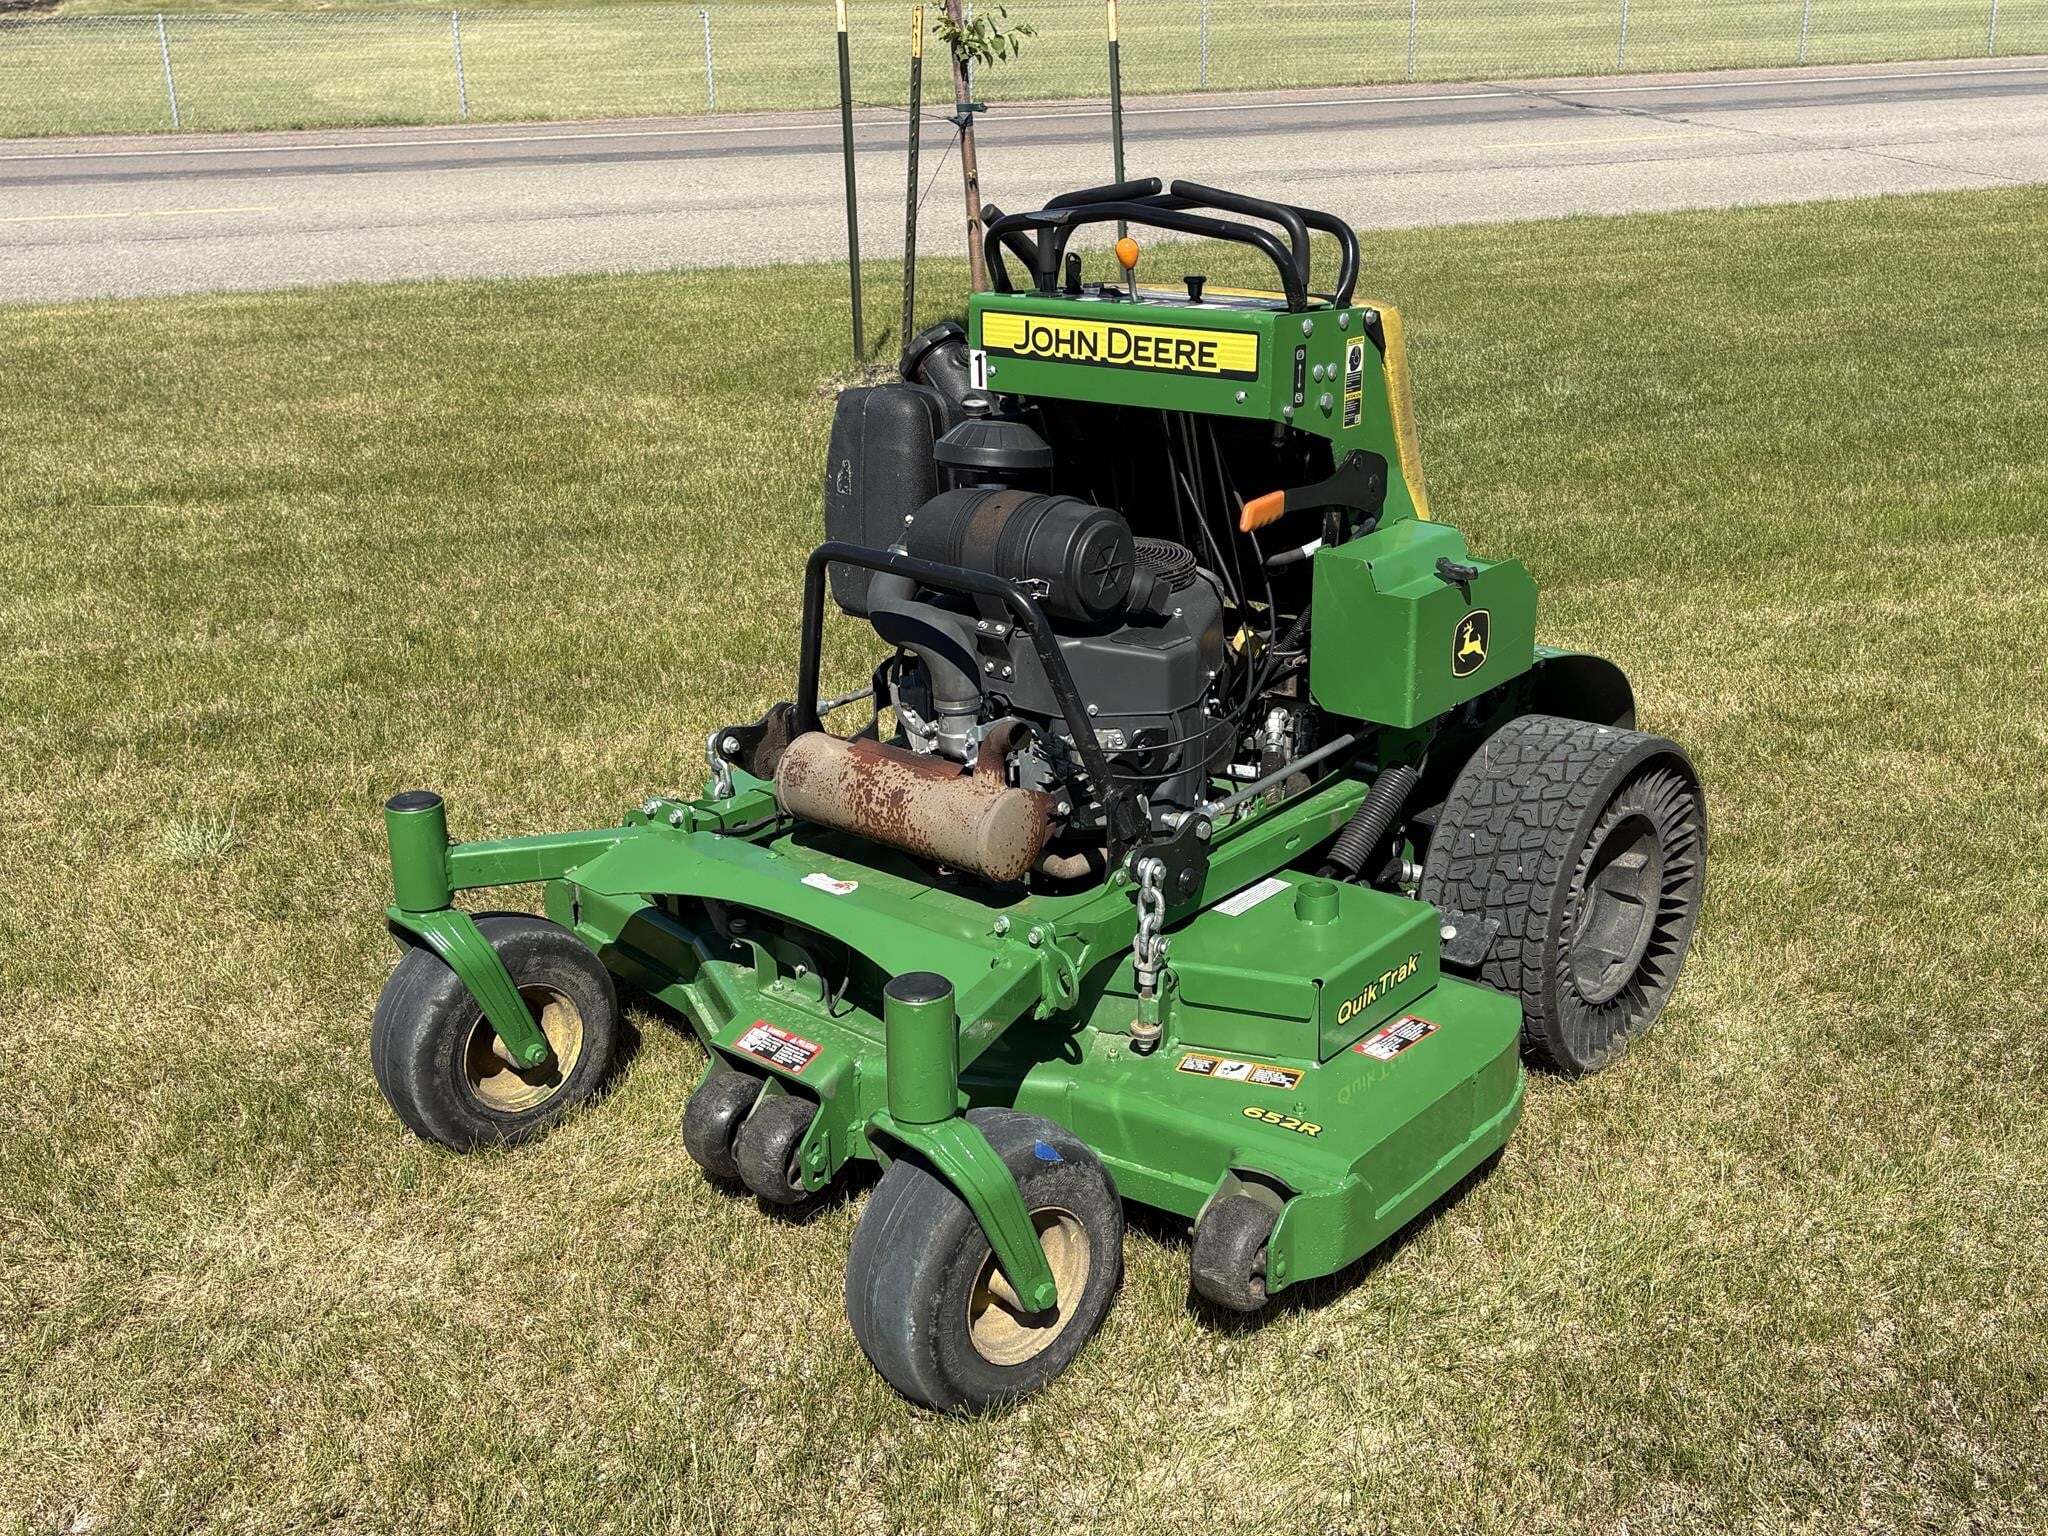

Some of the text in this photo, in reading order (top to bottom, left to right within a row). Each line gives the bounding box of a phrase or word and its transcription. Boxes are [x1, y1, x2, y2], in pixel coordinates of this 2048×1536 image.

[1014, 320, 1218, 369] JOHN DEERE
[974, 352, 984, 388] 1
[1337, 955, 1418, 1025] Quik Trak
[1242, 1106, 1322, 1137] 652R
